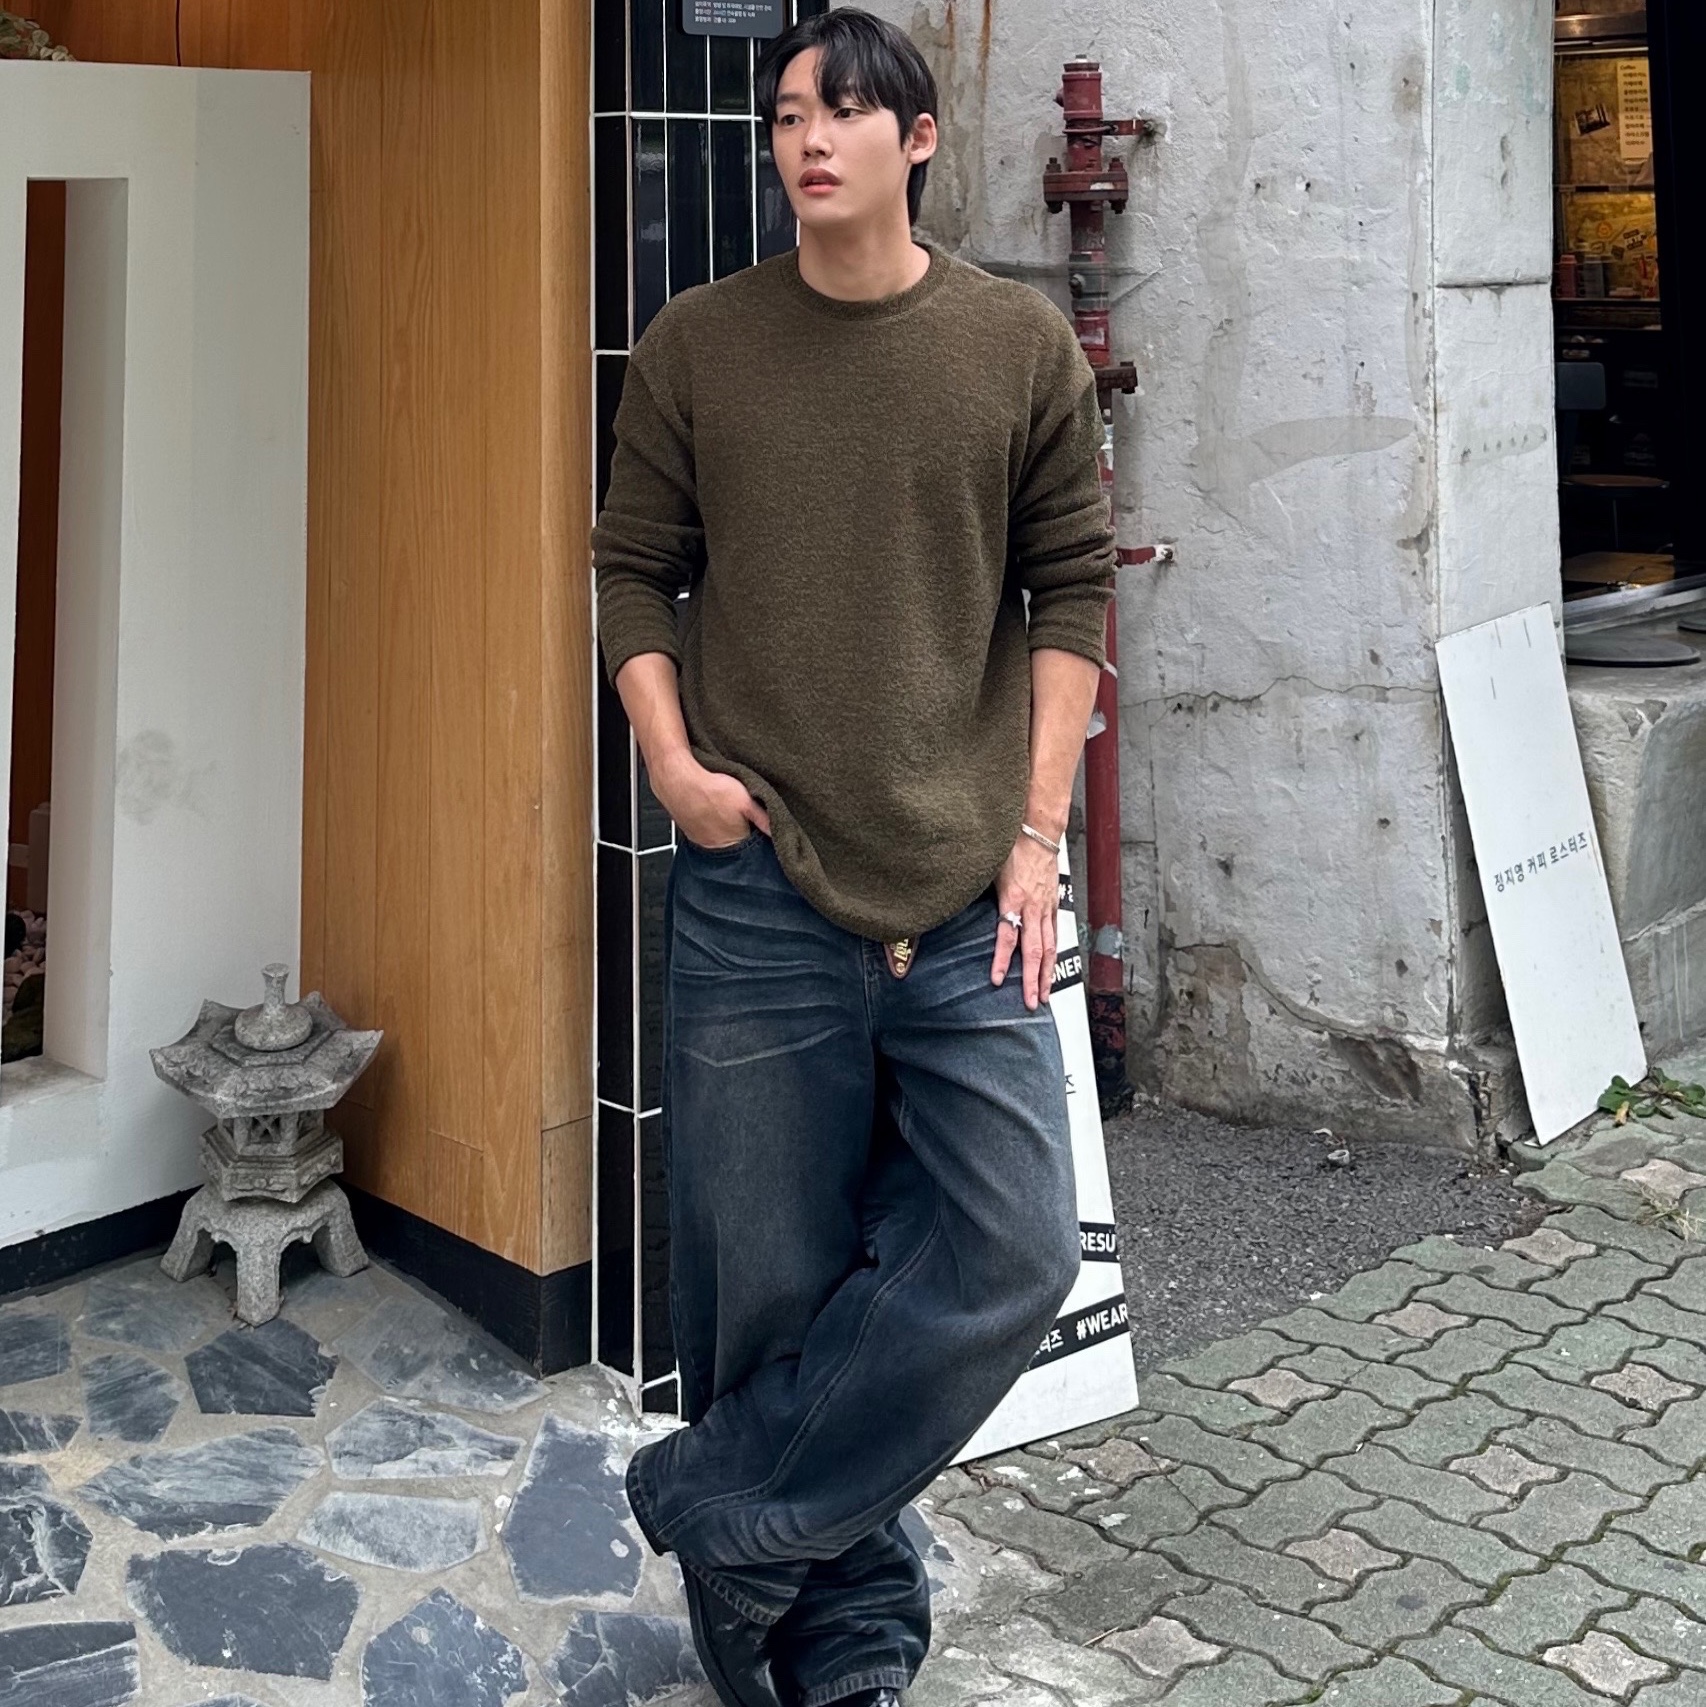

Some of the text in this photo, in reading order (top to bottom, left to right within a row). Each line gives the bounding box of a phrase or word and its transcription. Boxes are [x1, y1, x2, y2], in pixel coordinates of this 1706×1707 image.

[1494, 832, 1588, 892] 정지영 커피 로스터즈
[1079, 1231, 1116, 1253] RESU
[1076, 1302, 1129, 1341] #WEAR
